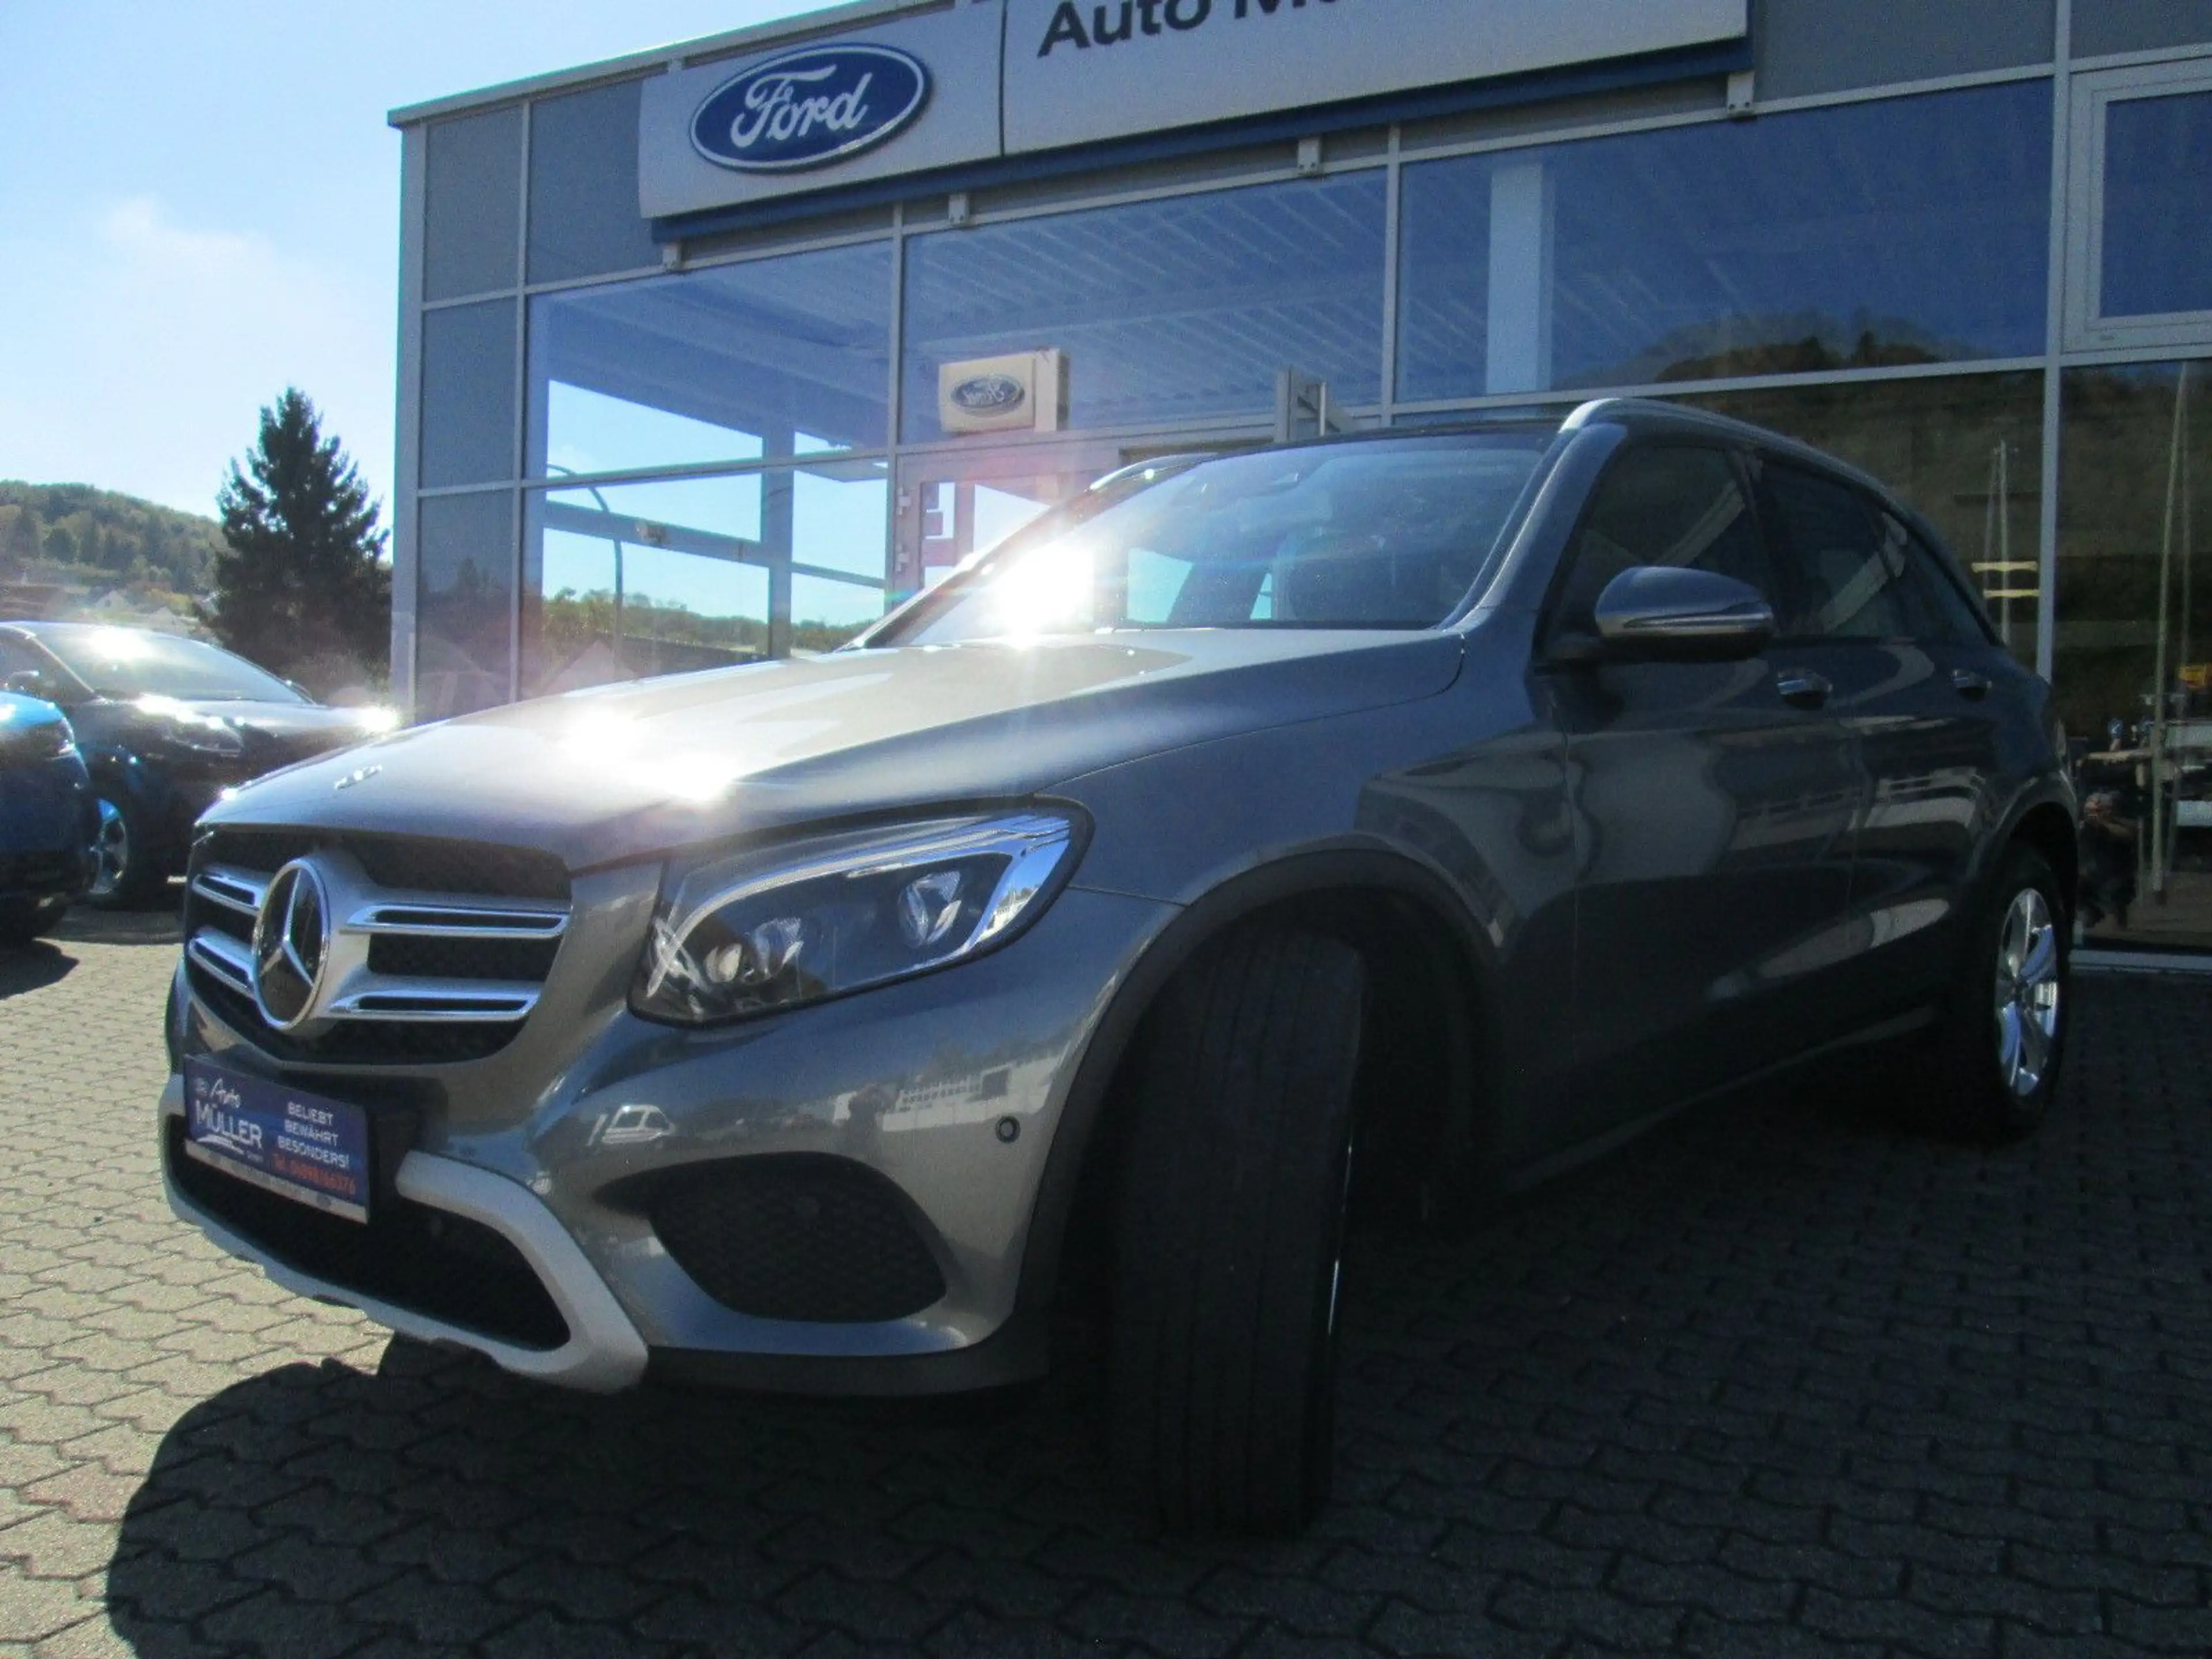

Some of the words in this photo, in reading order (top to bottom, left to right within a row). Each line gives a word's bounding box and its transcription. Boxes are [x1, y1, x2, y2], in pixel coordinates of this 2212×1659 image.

[1037, 0, 1212, 58] Auto
[730, 63, 873, 149] Ford
[195, 1099, 263, 1149] MÜLLER
[287, 1101, 334, 1126] BELIEBT
